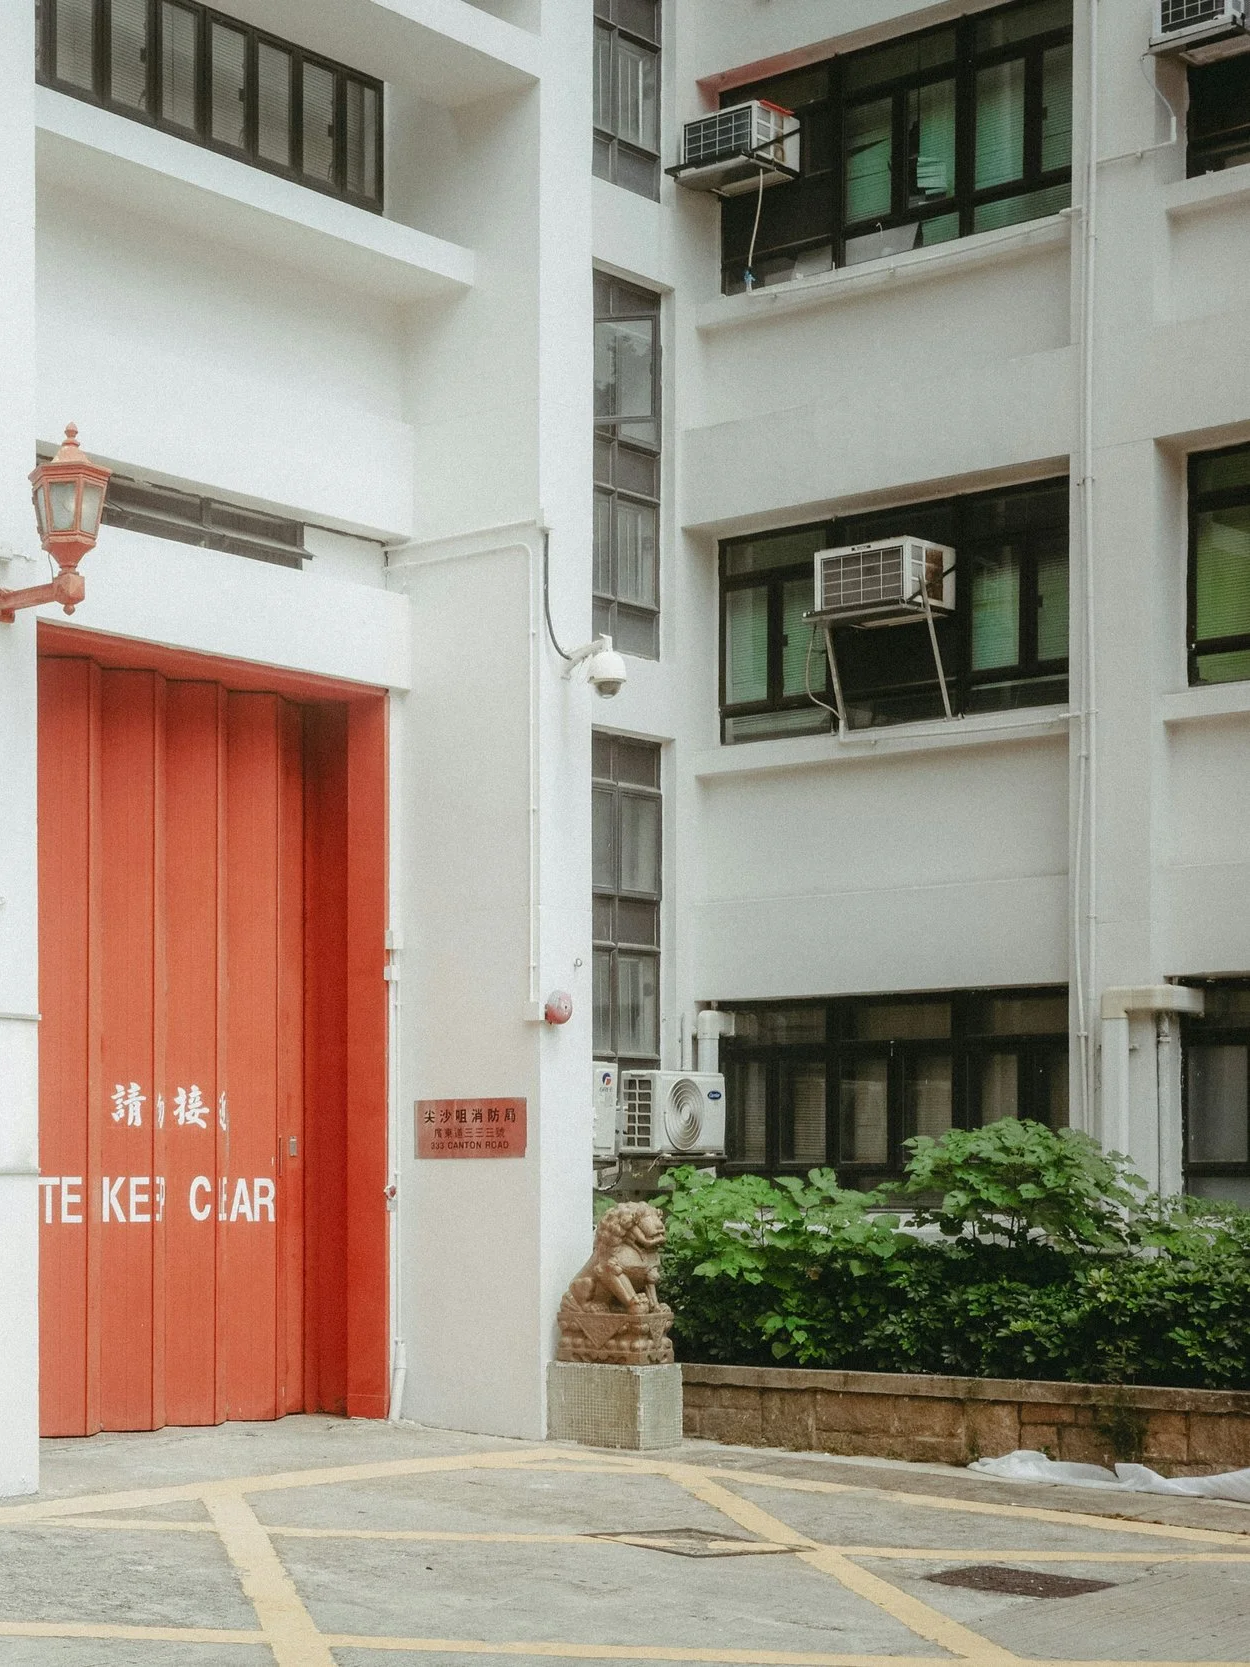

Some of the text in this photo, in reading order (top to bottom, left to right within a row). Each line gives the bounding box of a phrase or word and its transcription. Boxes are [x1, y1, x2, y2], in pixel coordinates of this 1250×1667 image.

[424, 1108, 516, 1123] 尖沙咀消防局
[431, 1141, 509, 1150] 333 CANTON ROAD
